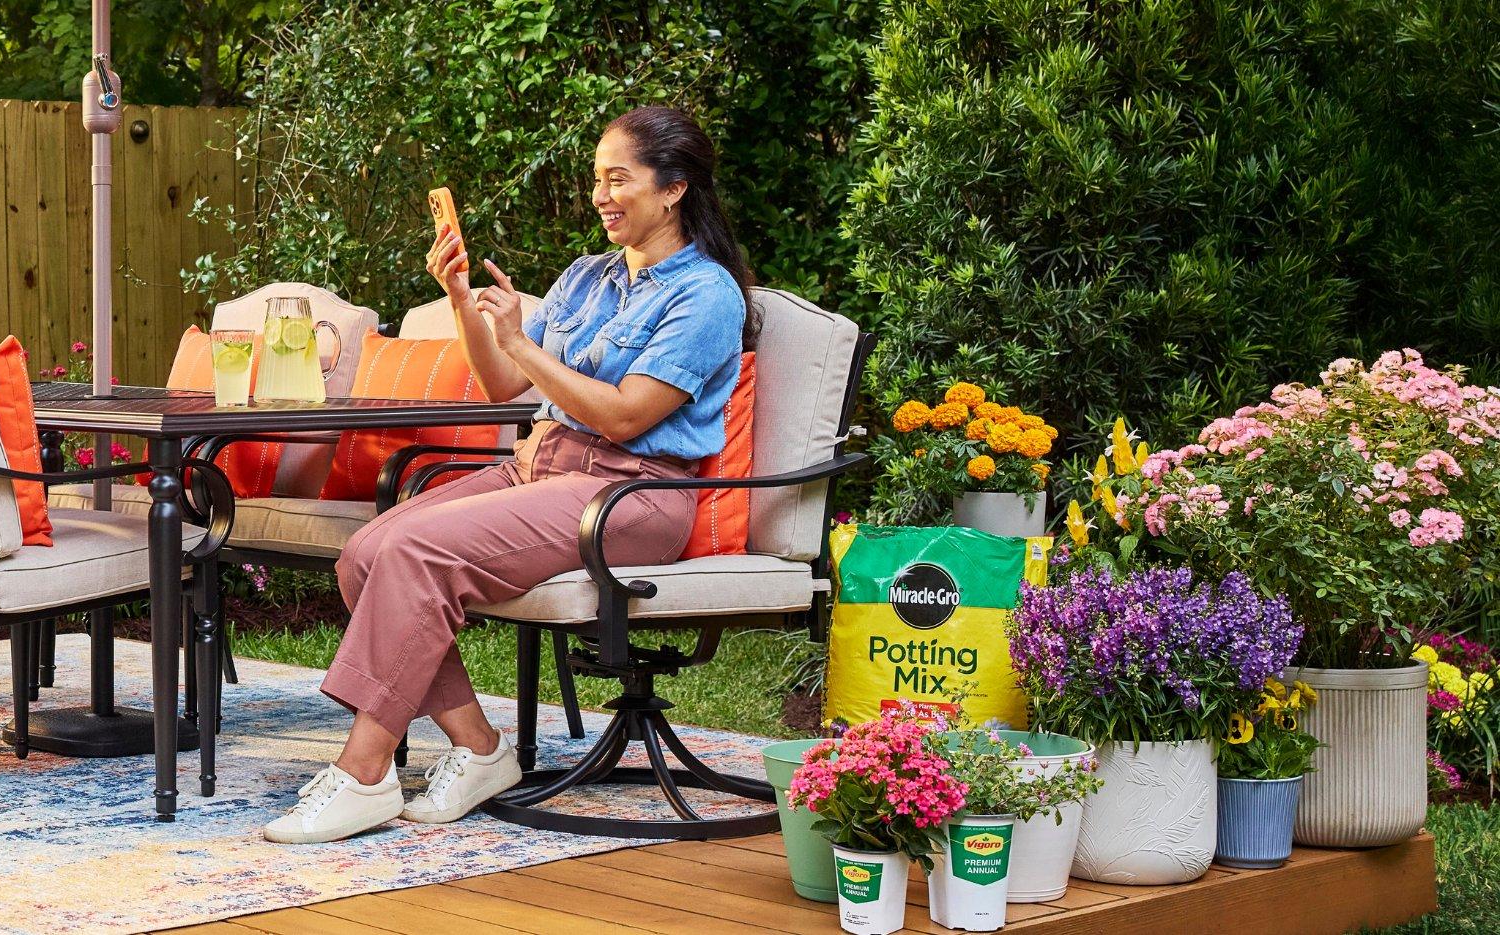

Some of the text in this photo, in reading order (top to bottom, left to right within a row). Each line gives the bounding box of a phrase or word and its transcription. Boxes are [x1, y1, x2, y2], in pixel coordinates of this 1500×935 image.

[889, 586, 960, 606] Miracle-Gro
[869, 635, 978, 675] Potting
[894, 665, 947, 694] Mix
[966, 839, 1001, 850] Vigoro
[844, 869, 868, 879] Vigoro
[843, 882, 870, 892] PREMIUM
[845, 888, 868, 897] ANNUAL
